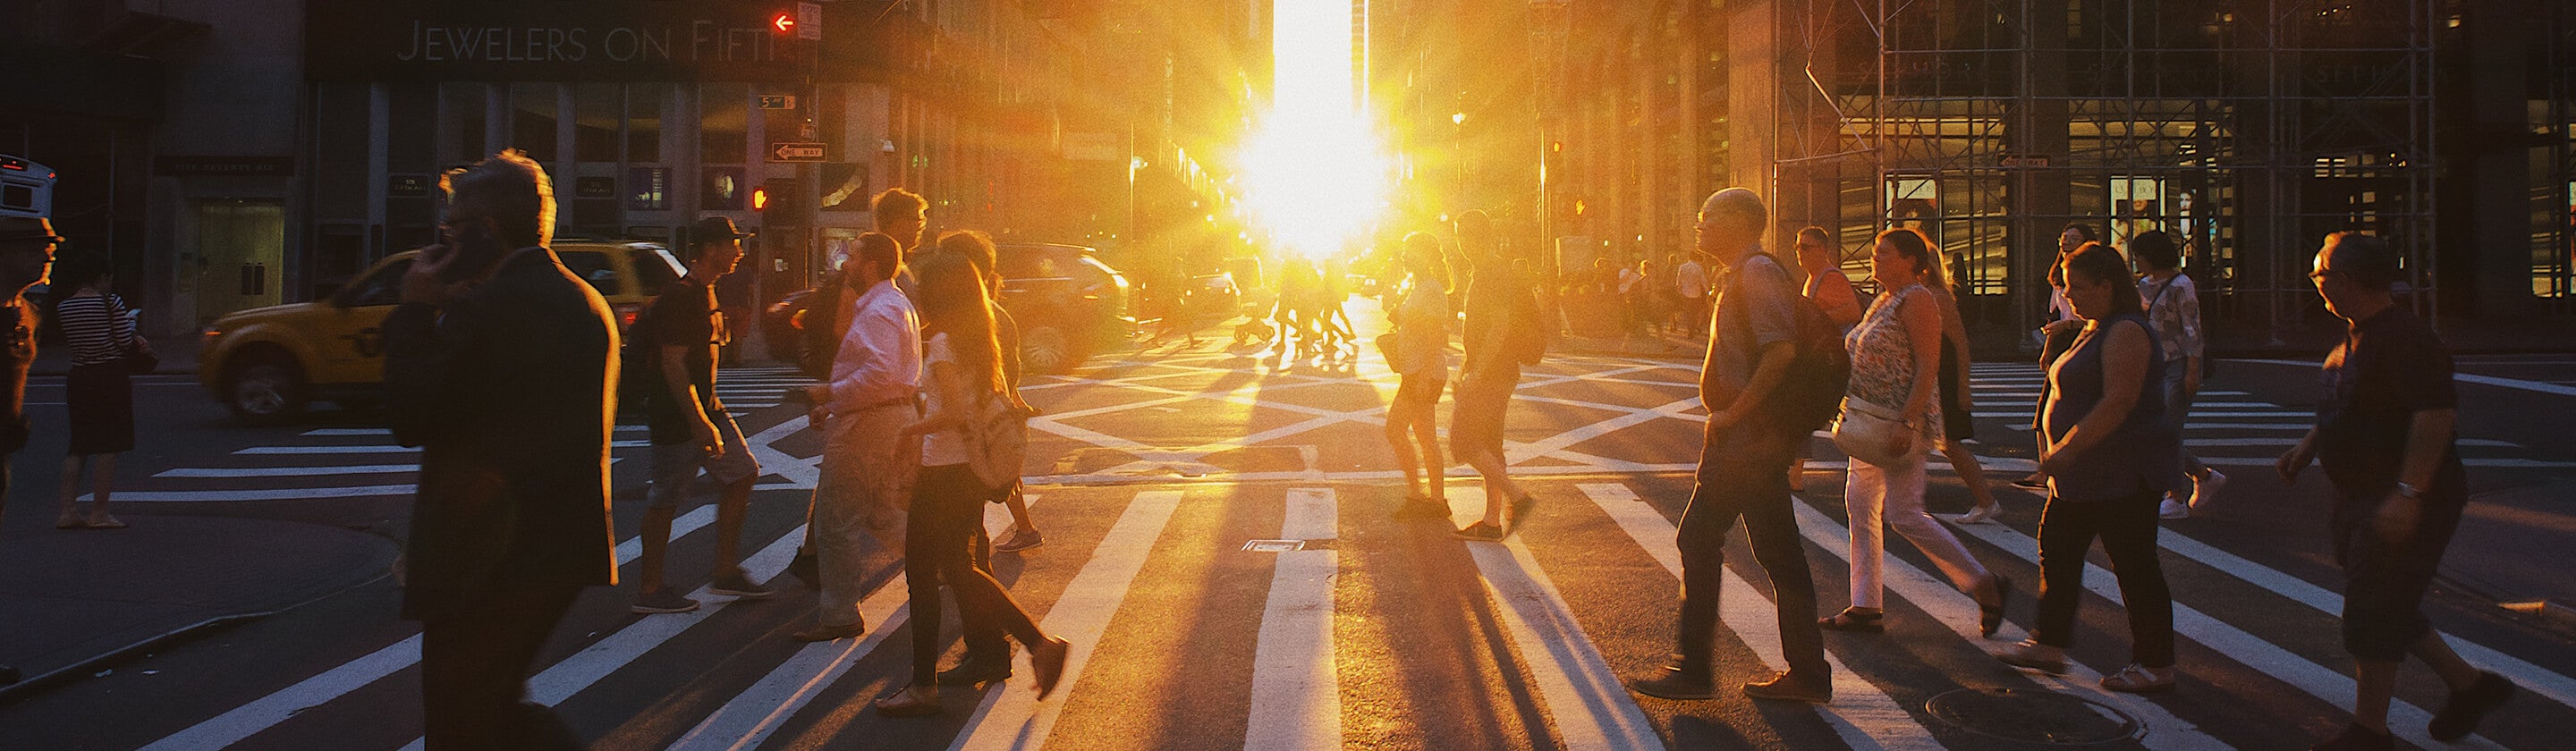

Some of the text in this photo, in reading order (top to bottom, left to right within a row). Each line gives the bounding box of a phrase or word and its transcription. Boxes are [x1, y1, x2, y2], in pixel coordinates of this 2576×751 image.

[396, 19, 587, 62] JEWELERS
[605, 27, 670, 62] ON
[761, 97, 769, 107] 5
[781, 148, 796, 156] ONE
